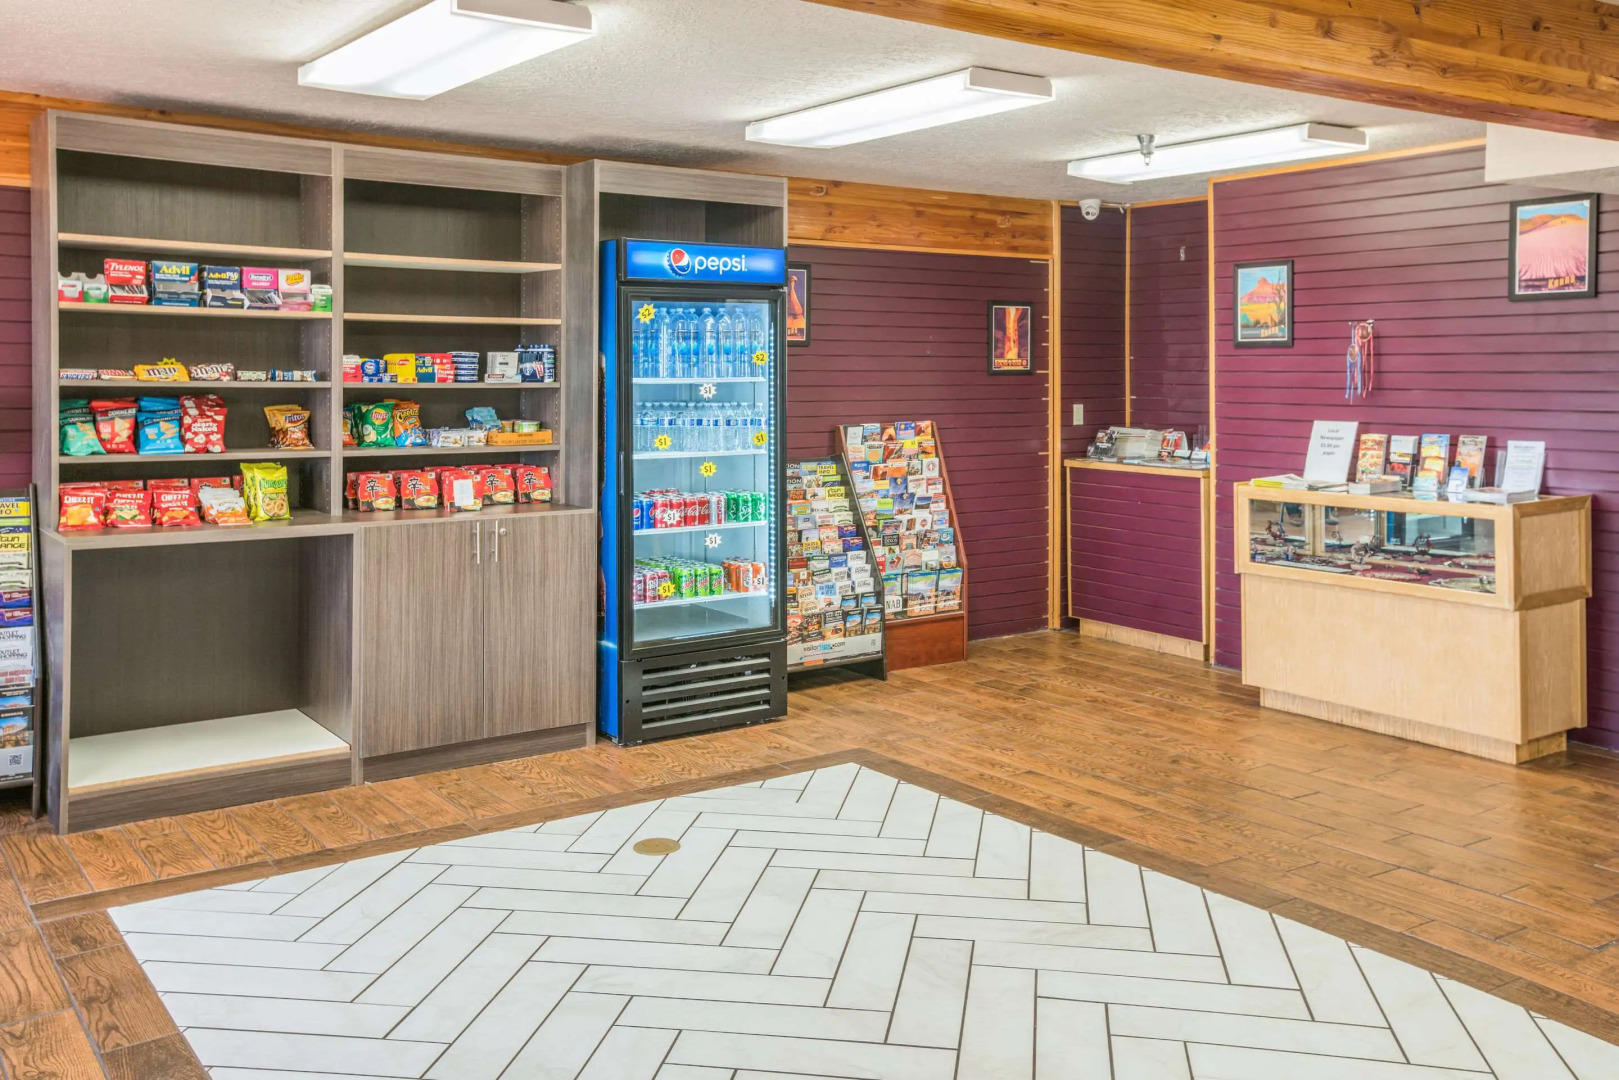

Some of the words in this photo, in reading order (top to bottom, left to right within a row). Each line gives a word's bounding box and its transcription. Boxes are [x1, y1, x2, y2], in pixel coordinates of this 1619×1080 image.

[110, 262, 144, 272] TYLENOL
[695, 254, 747, 275] pepsi
[160, 265, 190, 274] Advil
[108, 408, 136, 416] CORNERS
[658, 438, 667, 446] $1
[704, 465, 712, 474] $1
[485, 474, 498, 492] 辛
[524, 472, 538, 490] 辛
[366, 478, 380, 498] 辛
[409, 476, 423, 496] 辛
[668, 513, 676, 521] $1
[709, 536, 717, 544] $1
[662, 586, 671, 594] $1
